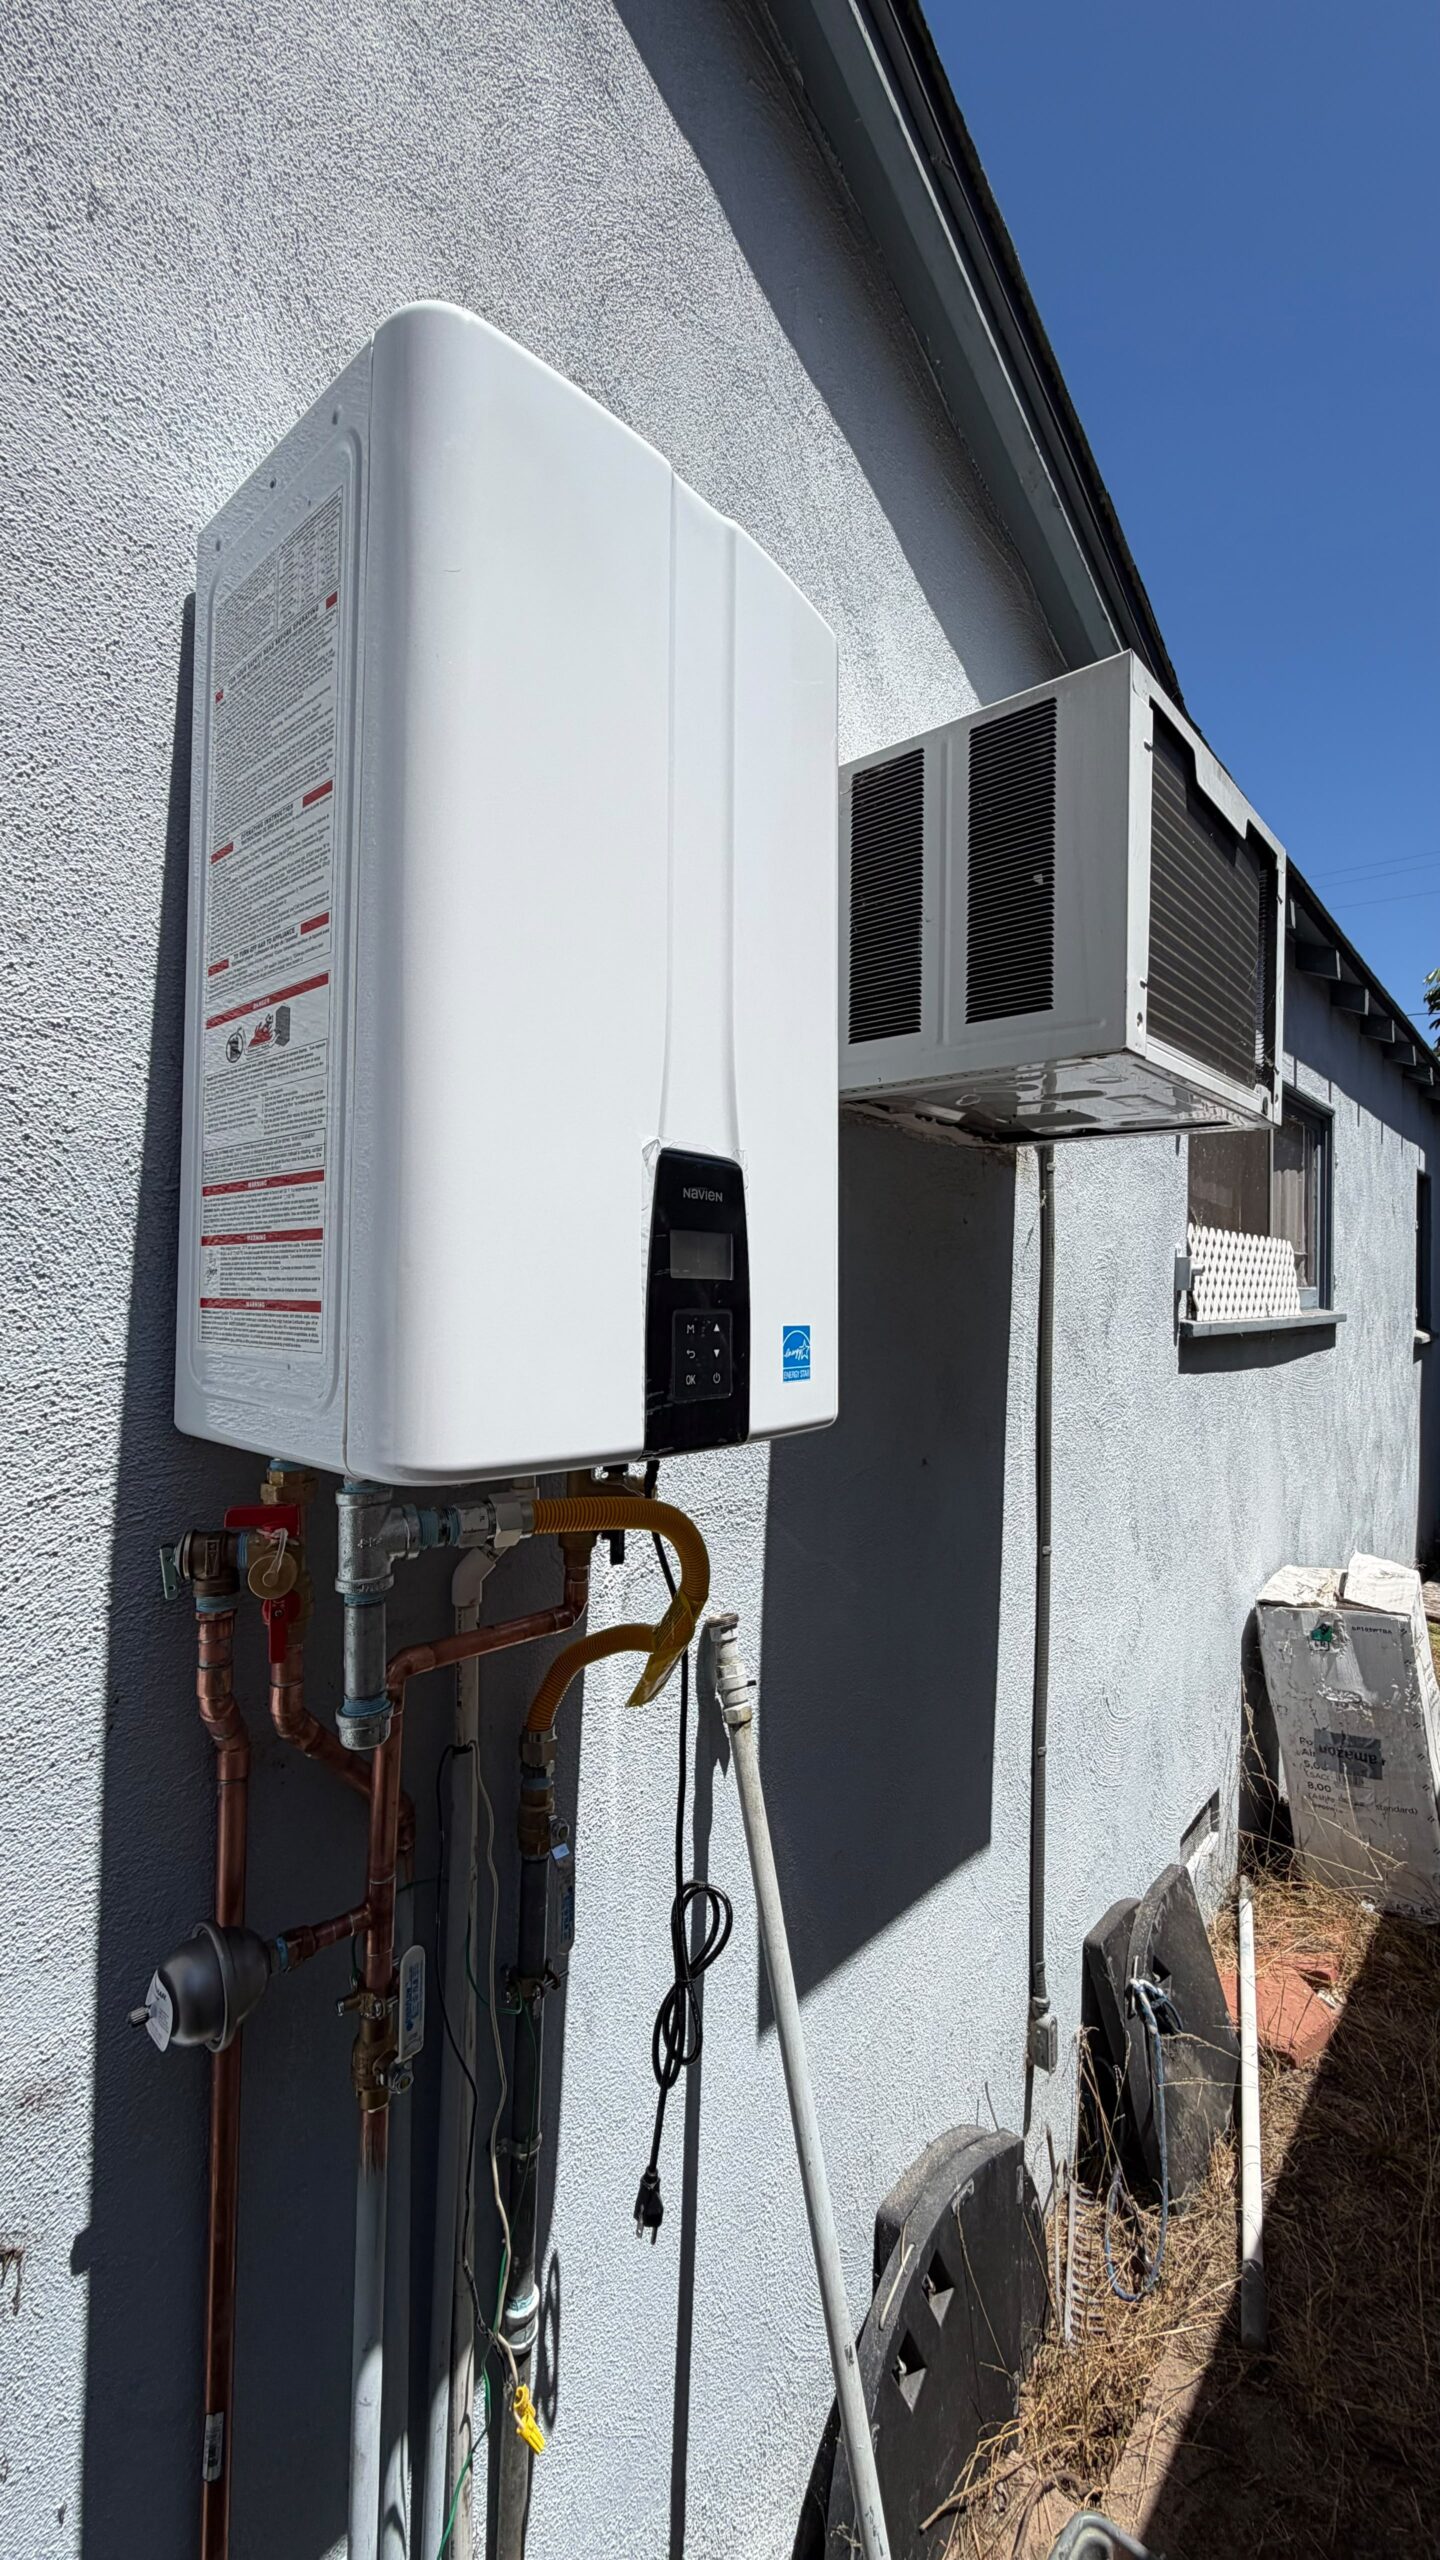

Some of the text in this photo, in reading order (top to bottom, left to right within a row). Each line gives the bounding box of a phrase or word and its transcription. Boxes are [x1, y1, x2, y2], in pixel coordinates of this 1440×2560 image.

[686, 1324, 695, 1334] M
[685, 1374, 697, 1386] OK
[1318, 1744, 1378, 1766] amazon
